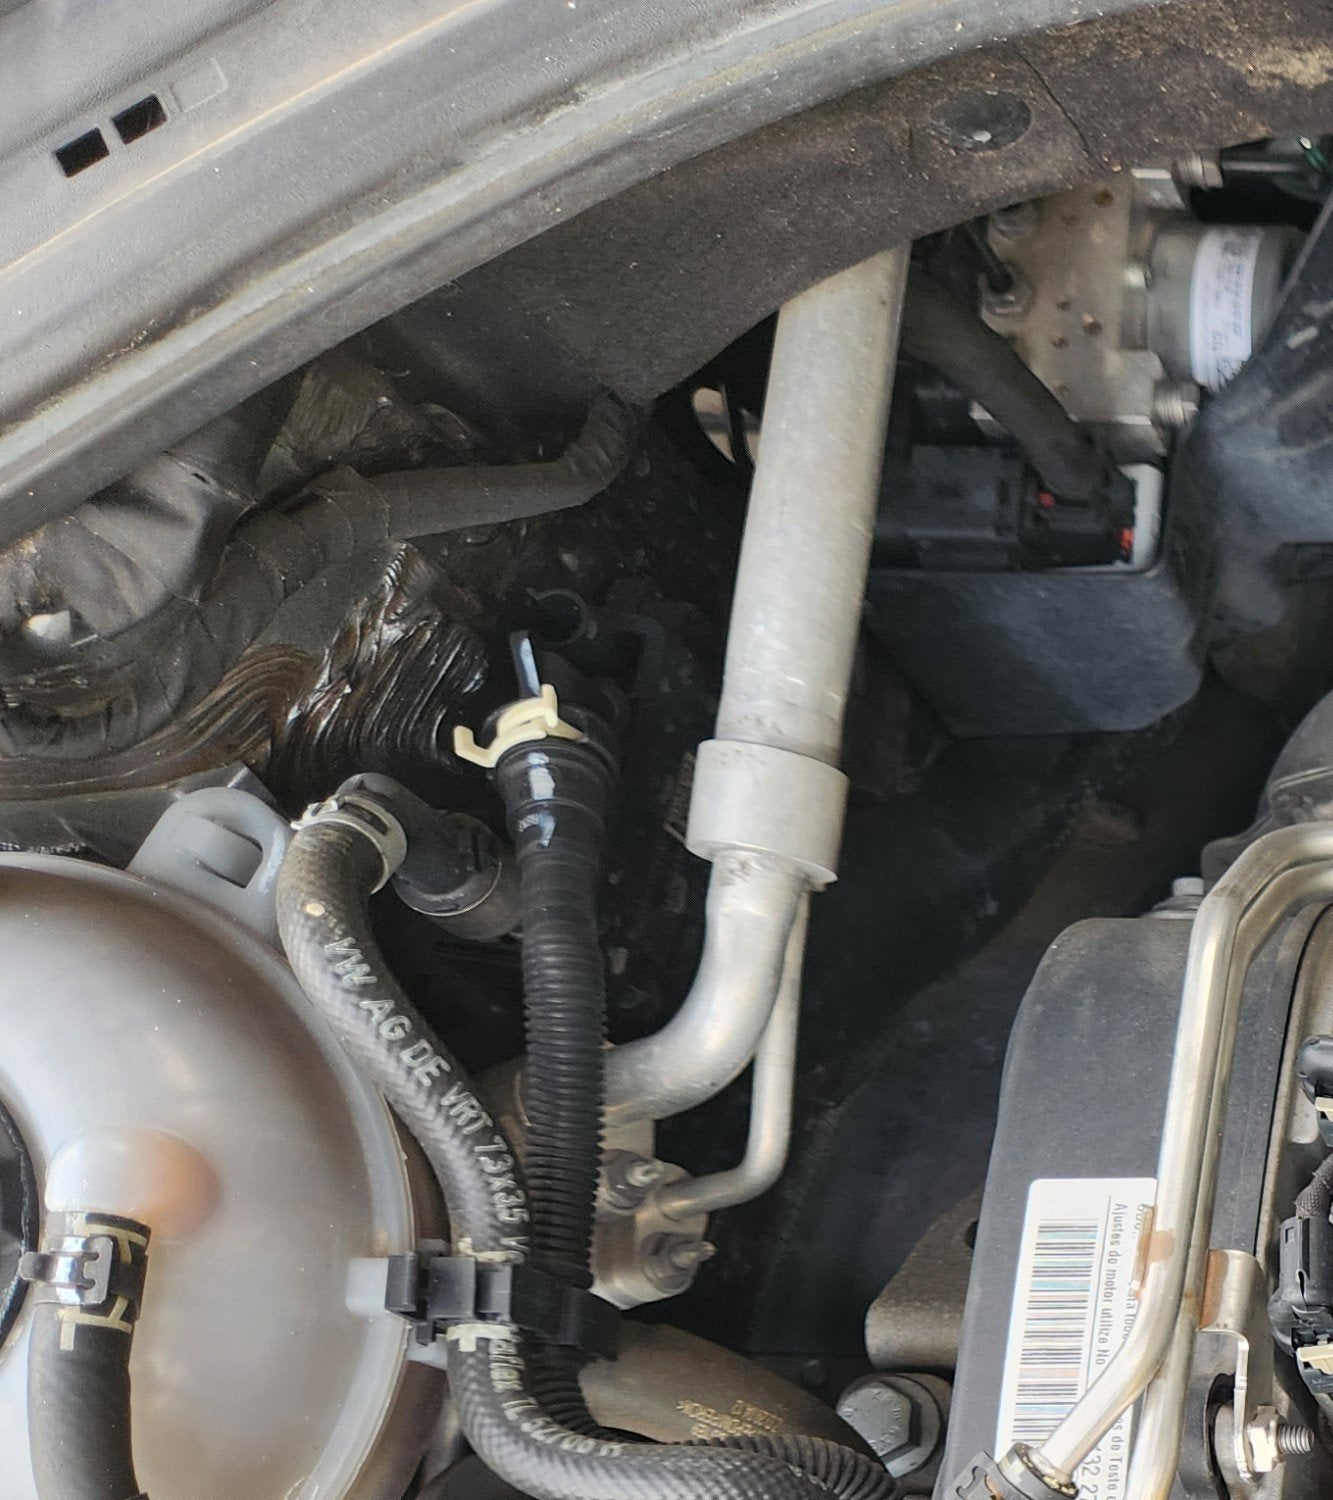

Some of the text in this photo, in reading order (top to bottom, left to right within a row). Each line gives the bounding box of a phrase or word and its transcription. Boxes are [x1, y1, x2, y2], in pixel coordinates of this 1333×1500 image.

[323, 936, 378, 989] VW
[359, 998, 411, 1041] AG
[400, 1041, 449, 1087] DE
[441, 1081, 492, 1132] VRT
[1095, 1203, 1127, 1365] Ajustes de motor utilize No
[1081, 1447, 1100, 1477] 32
